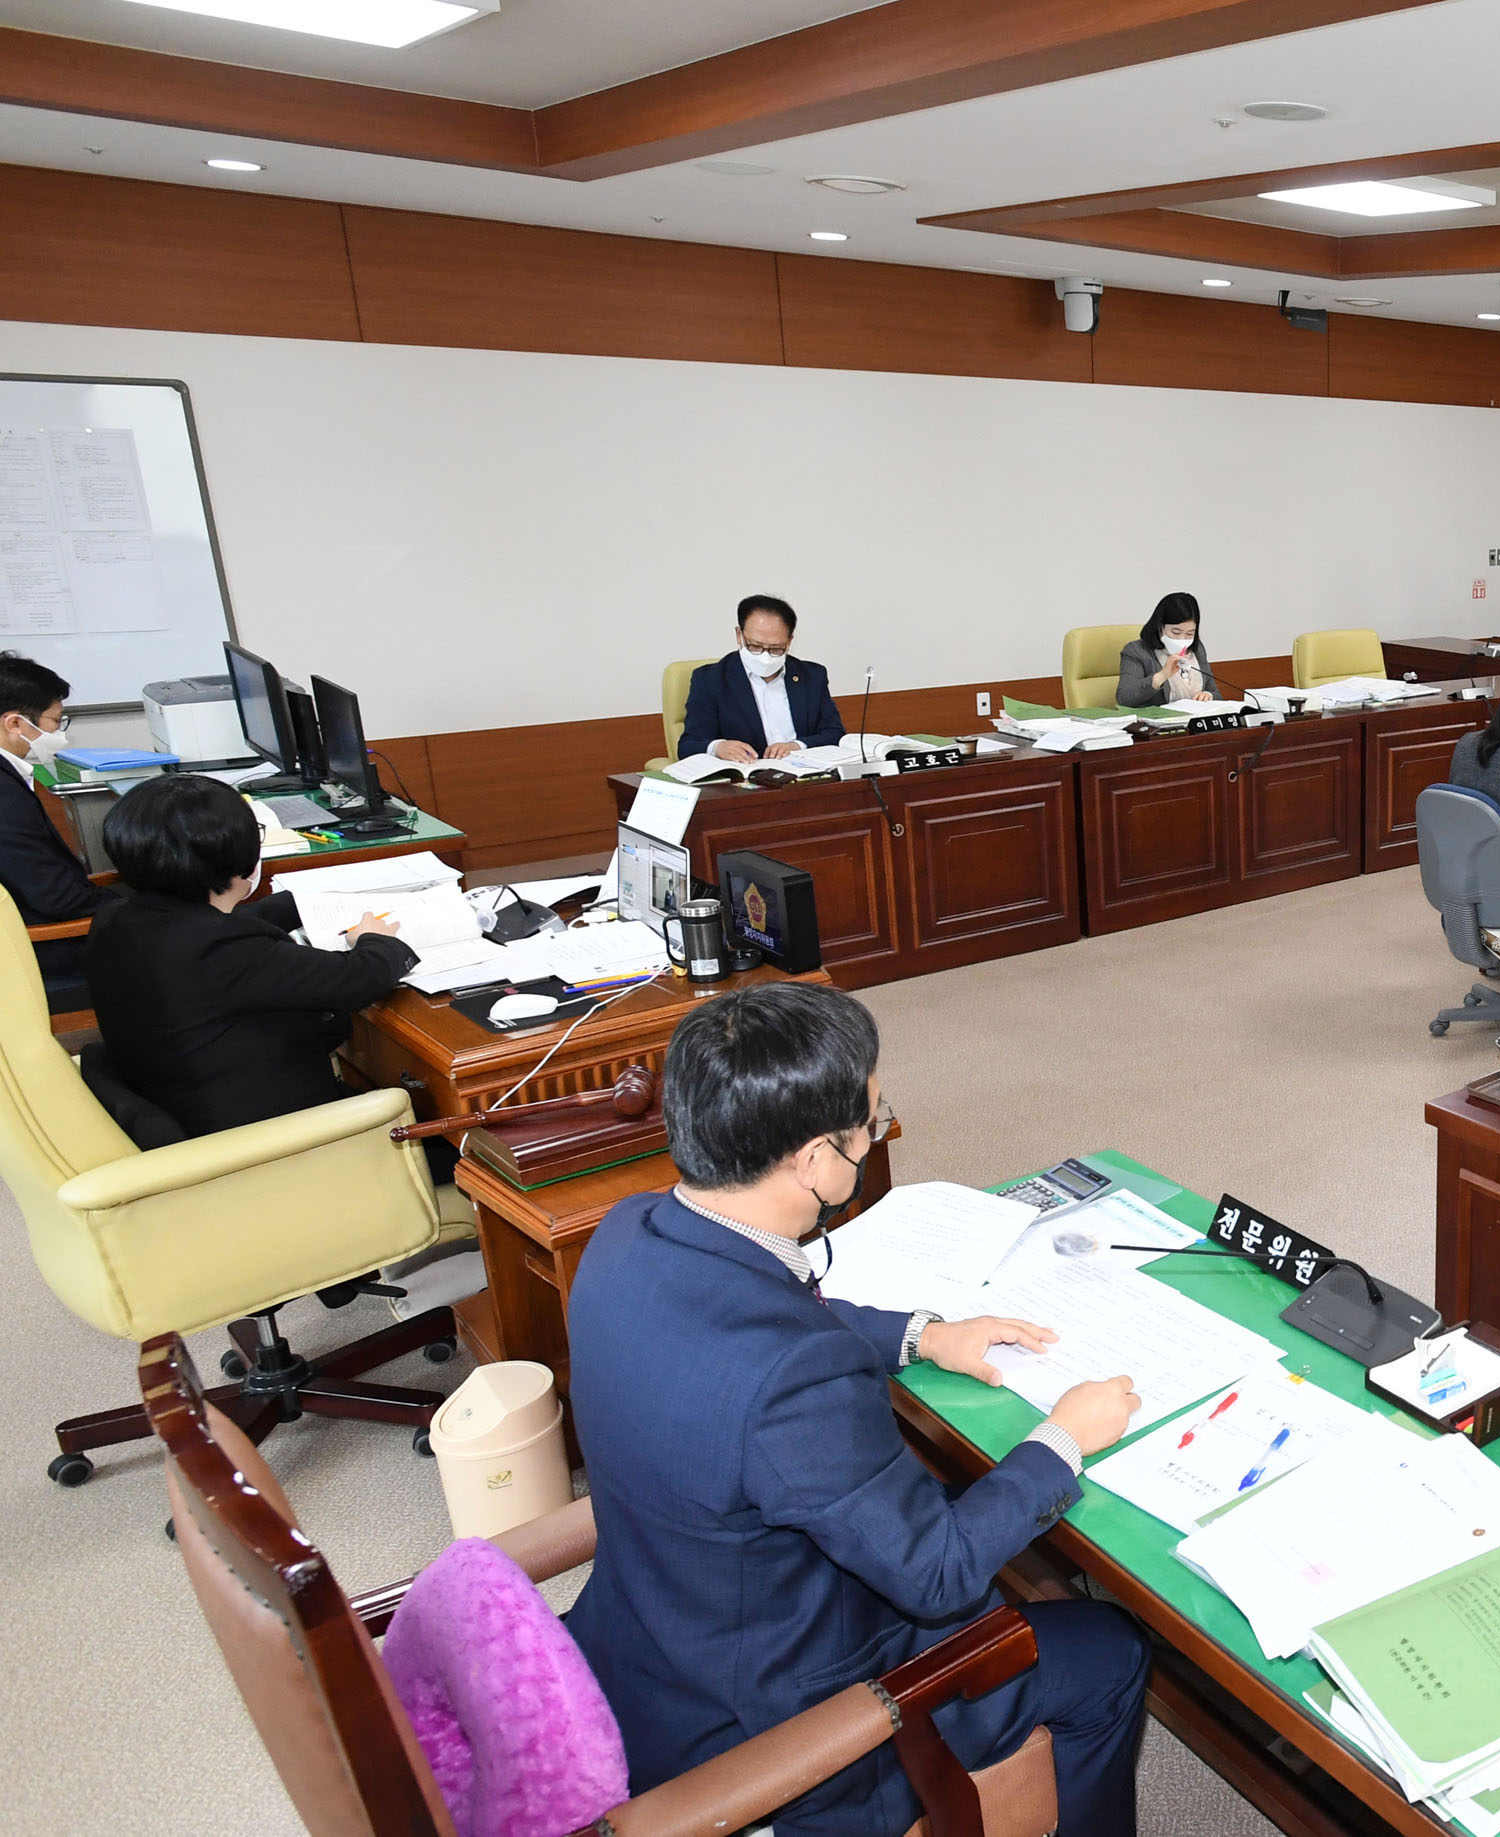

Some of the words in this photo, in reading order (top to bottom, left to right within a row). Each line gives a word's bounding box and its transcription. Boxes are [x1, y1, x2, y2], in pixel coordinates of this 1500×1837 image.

[1196, 715, 1239, 731] 이미영
[903, 752, 959, 768] 고호근
[1217, 1207, 1320, 1285] 전문위원
